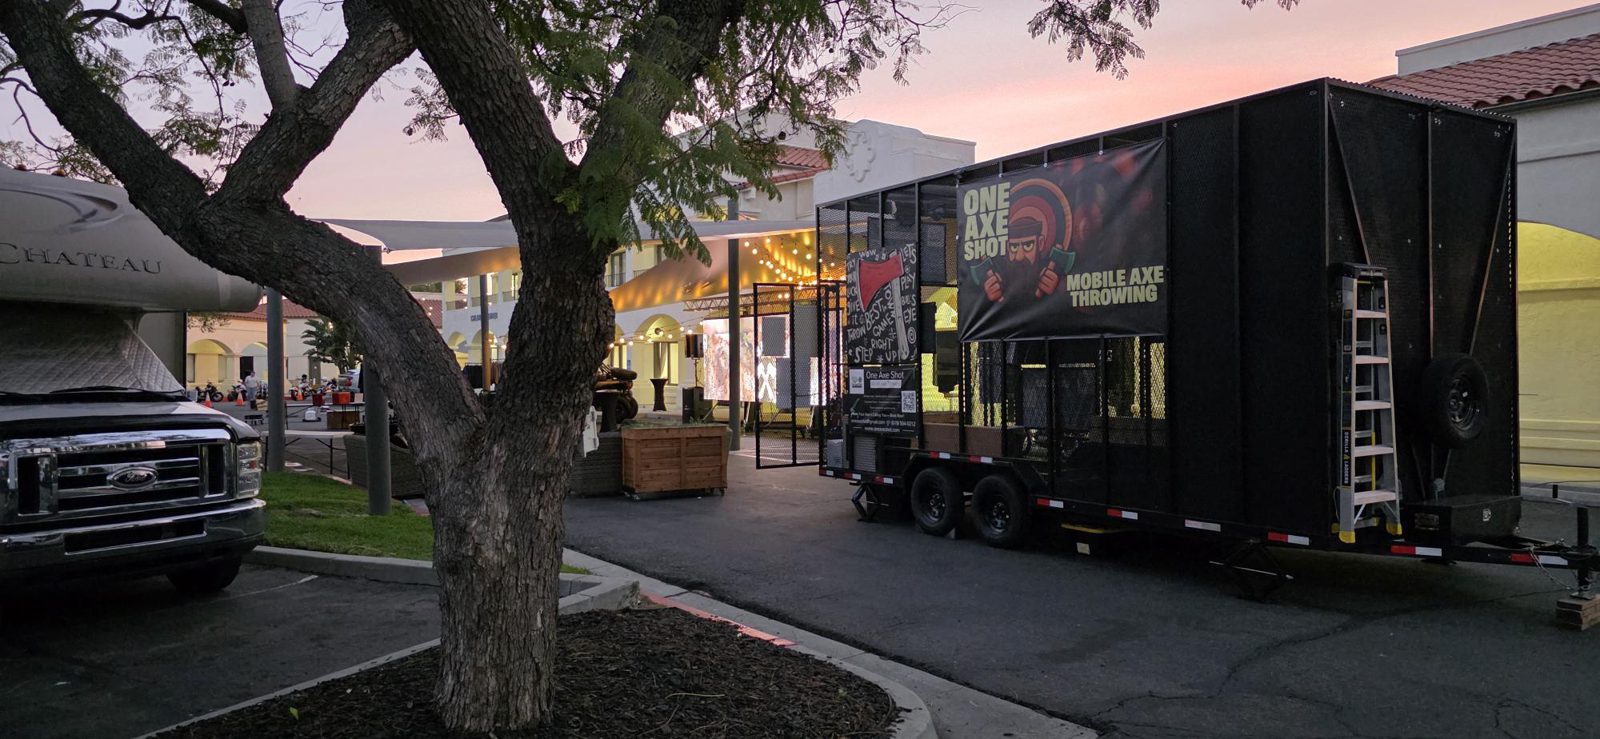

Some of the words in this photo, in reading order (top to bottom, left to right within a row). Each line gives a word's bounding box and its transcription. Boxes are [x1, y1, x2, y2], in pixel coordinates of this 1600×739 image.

[963, 182, 1010, 215] ONE
[964, 209, 1008, 241] AXE
[0, 243, 161, 274] CHATEAU
[964, 235, 1008, 261] SHOT
[1066, 269, 1126, 291] MOBILE
[1129, 265, 1165, 285] AXE
[1070, 284, 1158, 307] THROWING
[864, 297, 883, 331] BEST
[872, 313, 894, 337] GAME
[854, 346, 874, 363] STEP
[870, 337, 893, 351] RIGHT
[865, 371, 878, 379] One
[878, 371, 890, 379] Axe
[890, 371, 904, 379] Shot
